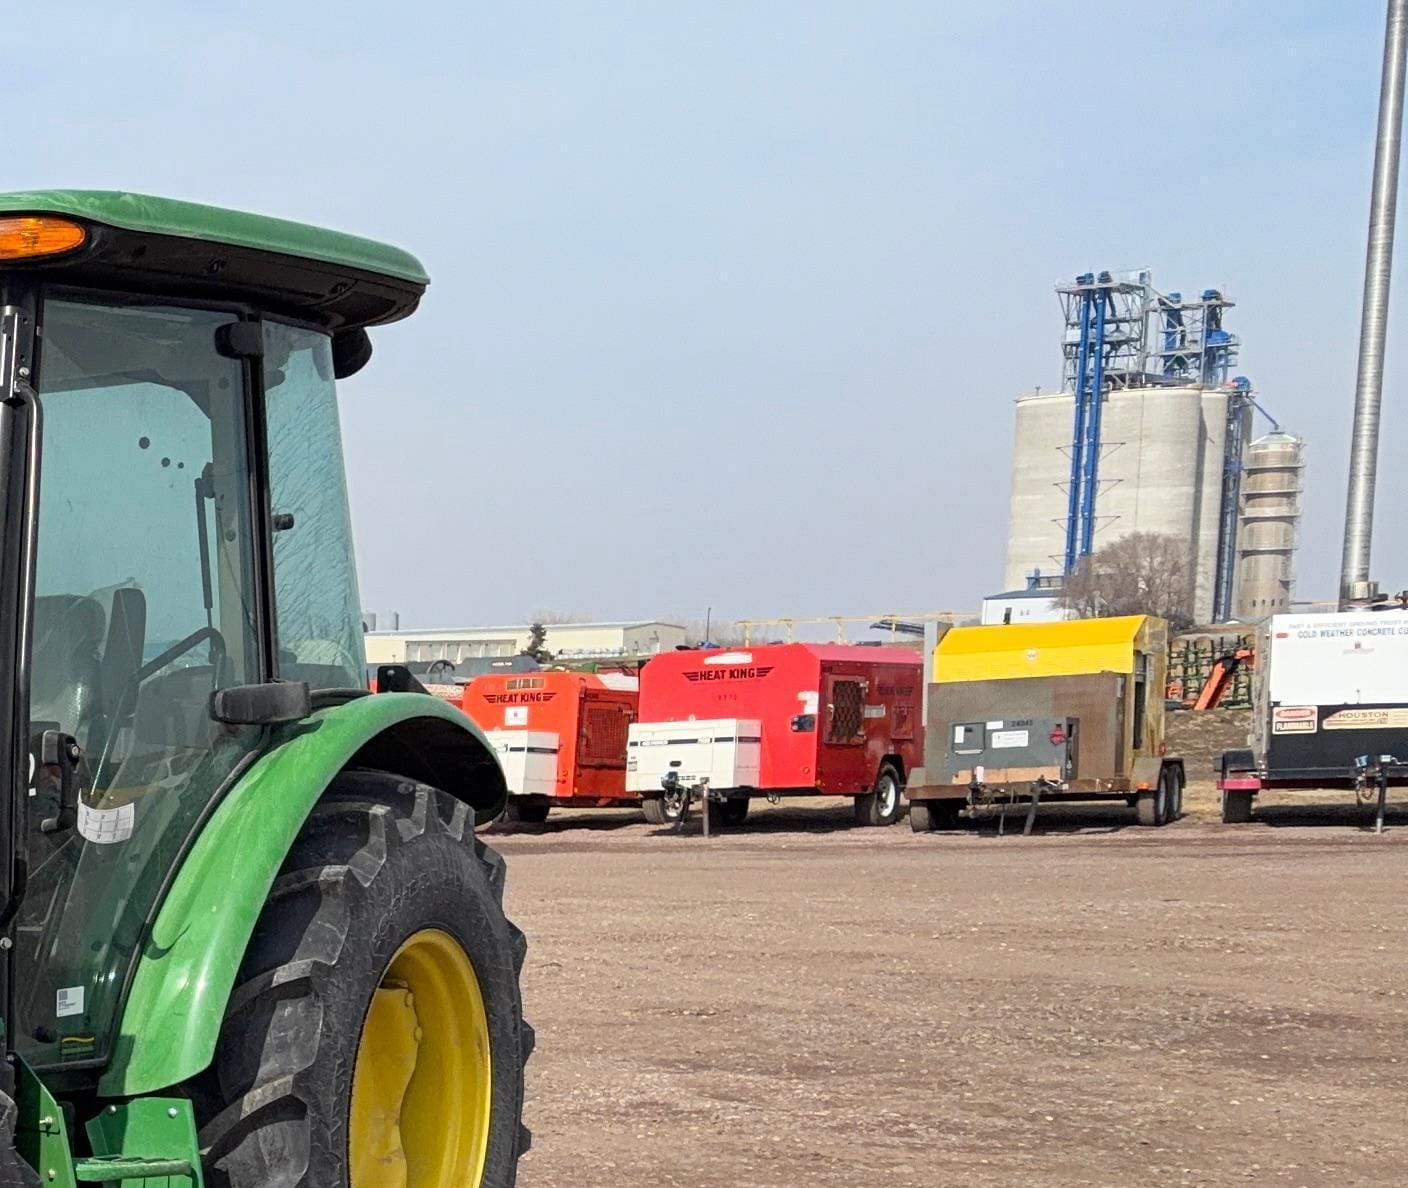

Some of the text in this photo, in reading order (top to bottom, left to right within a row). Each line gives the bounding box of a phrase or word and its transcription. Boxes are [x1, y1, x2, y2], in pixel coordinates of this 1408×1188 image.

[1297, 630, 1317, 638] COLD
[1320, 629, 1354, 638] WEATHER
[1357, 627, 1395, 636] CONCRETE
[699, 668, 755, 680] HEAT KING
[496, 692, 542, 703] HEAT KING
[1338, 711, 1389, 719] HOUSTON
